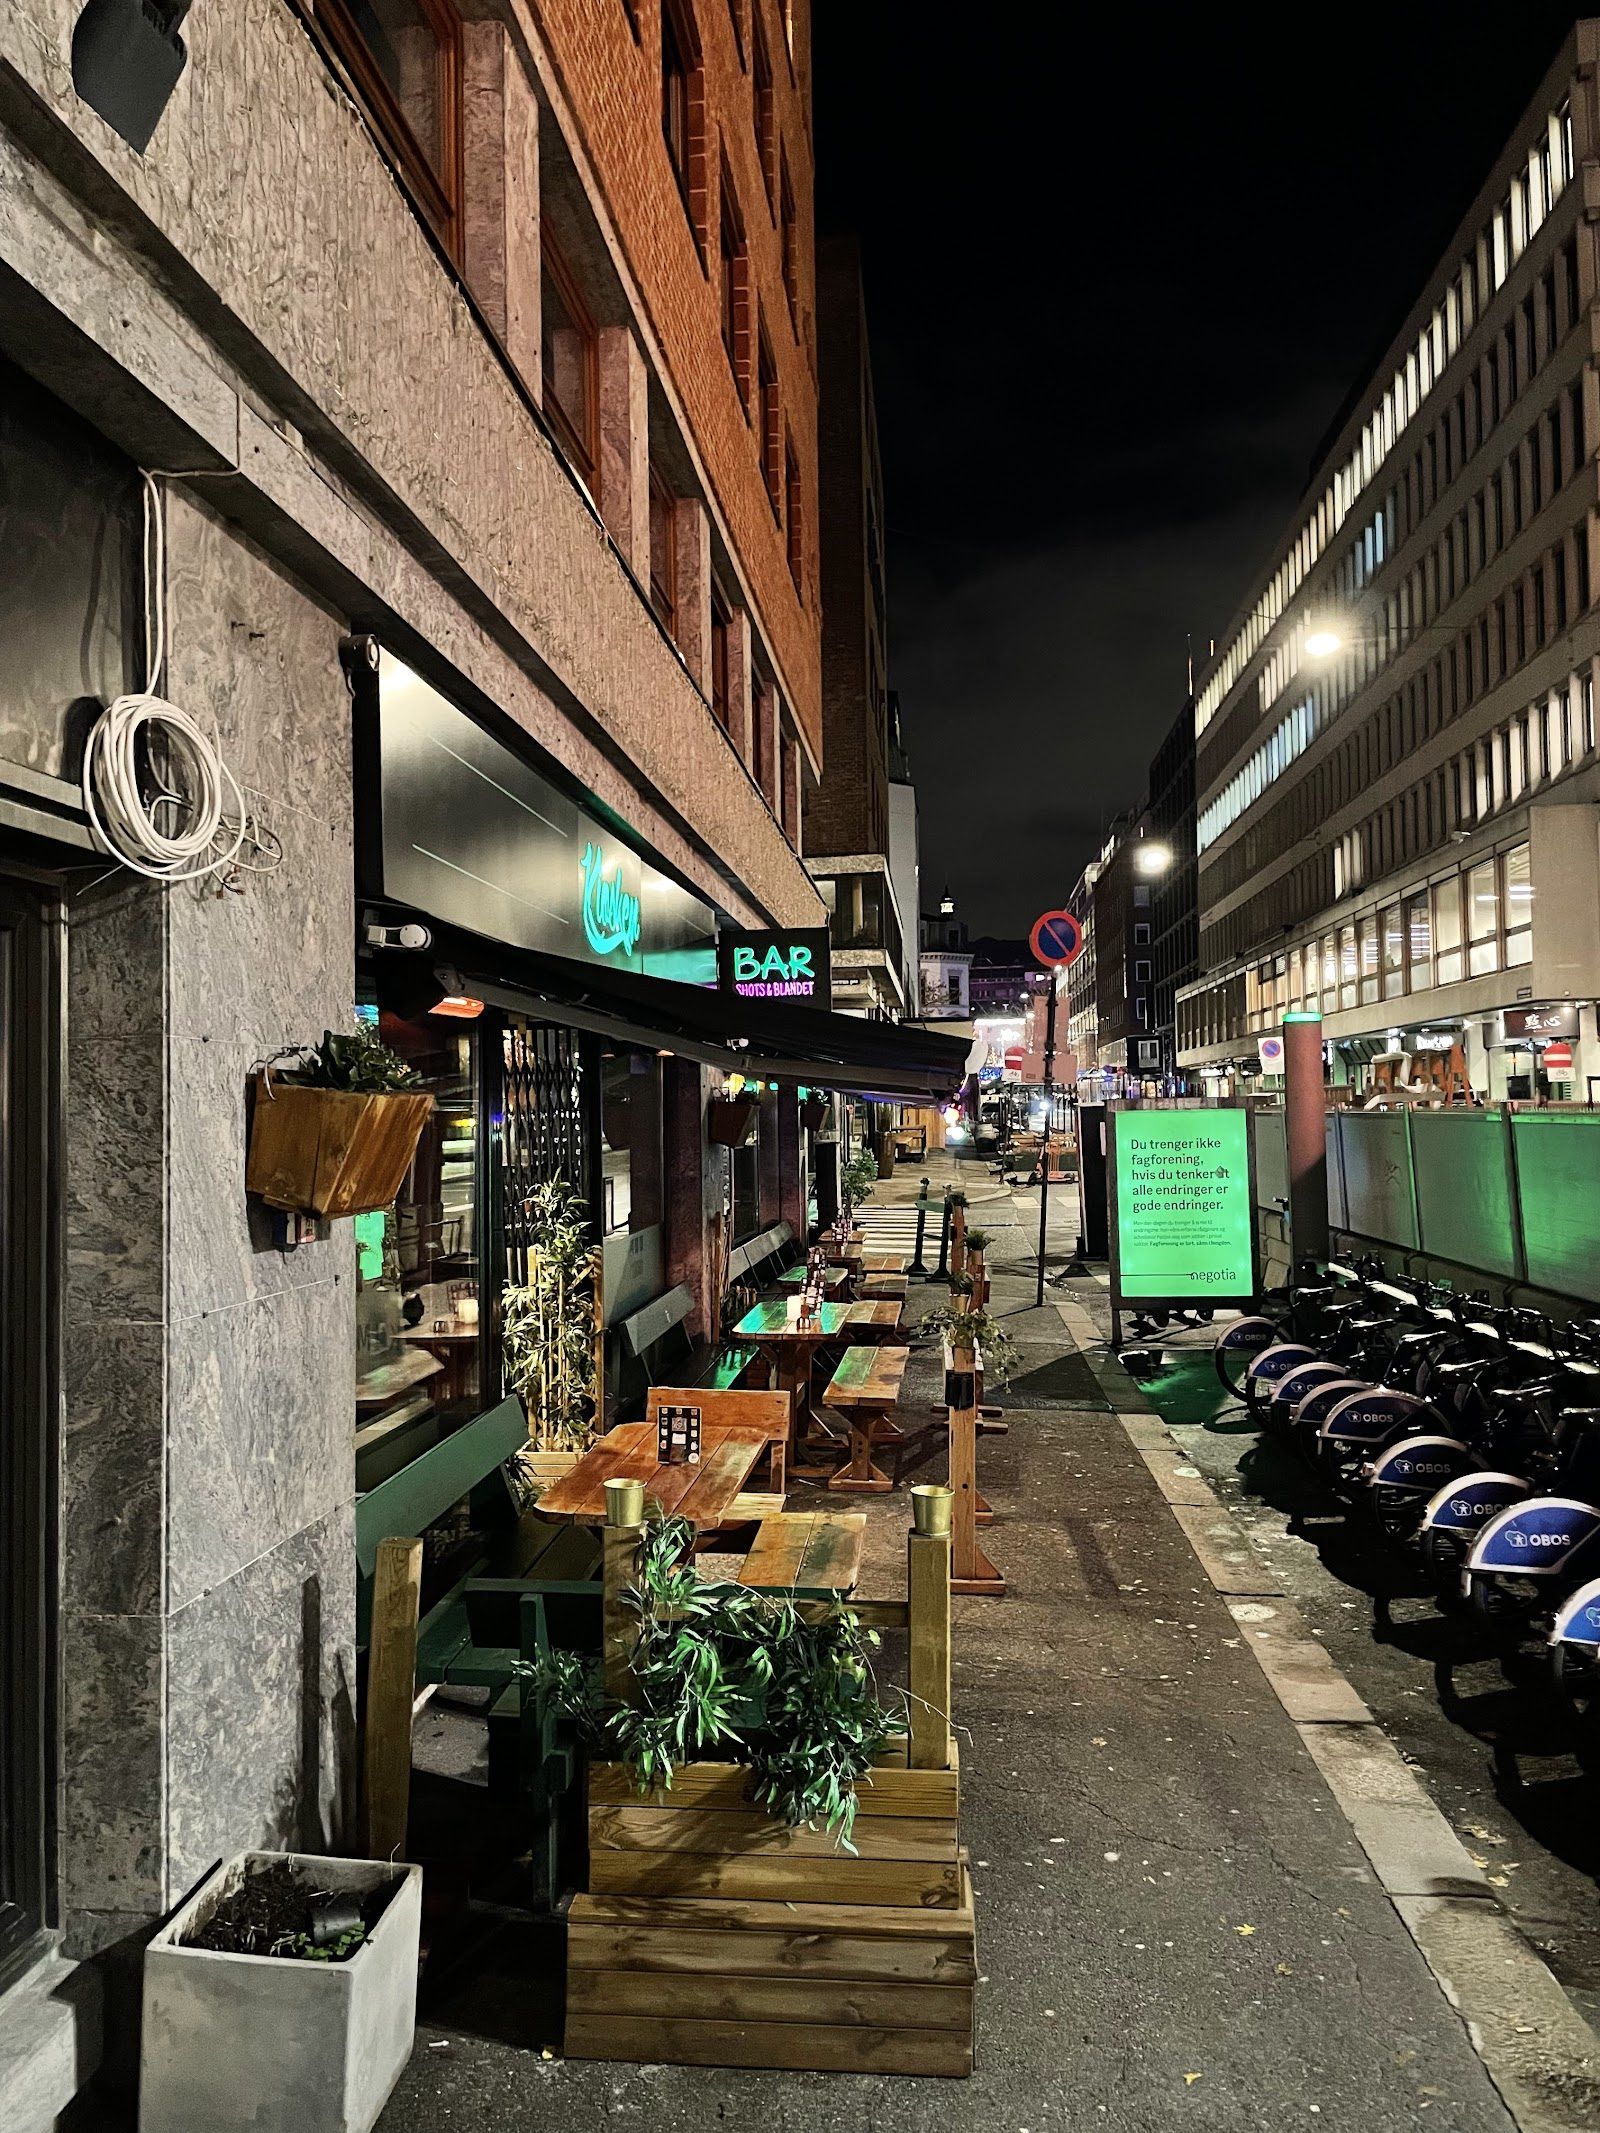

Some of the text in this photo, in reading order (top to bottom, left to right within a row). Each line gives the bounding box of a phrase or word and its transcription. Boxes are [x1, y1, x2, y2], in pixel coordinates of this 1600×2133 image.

[733, 945, 815, 981] BAR
[1131, 1137, 1221, 1152] Du trenger ikke
[1131, 1153, 1204, 1168] fagforening,
[1132, 1169, 1156, 1180] hvis
[1158, 1169, 1173, 1180] du
[1176, 1168, 1215, 1180] tenker
[1132, 1184, 1229, 1197] alle endringer er
[1133, 1199, 1224, 1214] gode endringer.
[1190, 1268, 1236, 1283] negotia
[1362, 1413, 1394, 1423] OBOS
[1415, 1463, 1451, 1473] OBOS
[1473, 1503, 1509, 1515] OBO
[1529, 1534, 1571, 1547] OBOS
